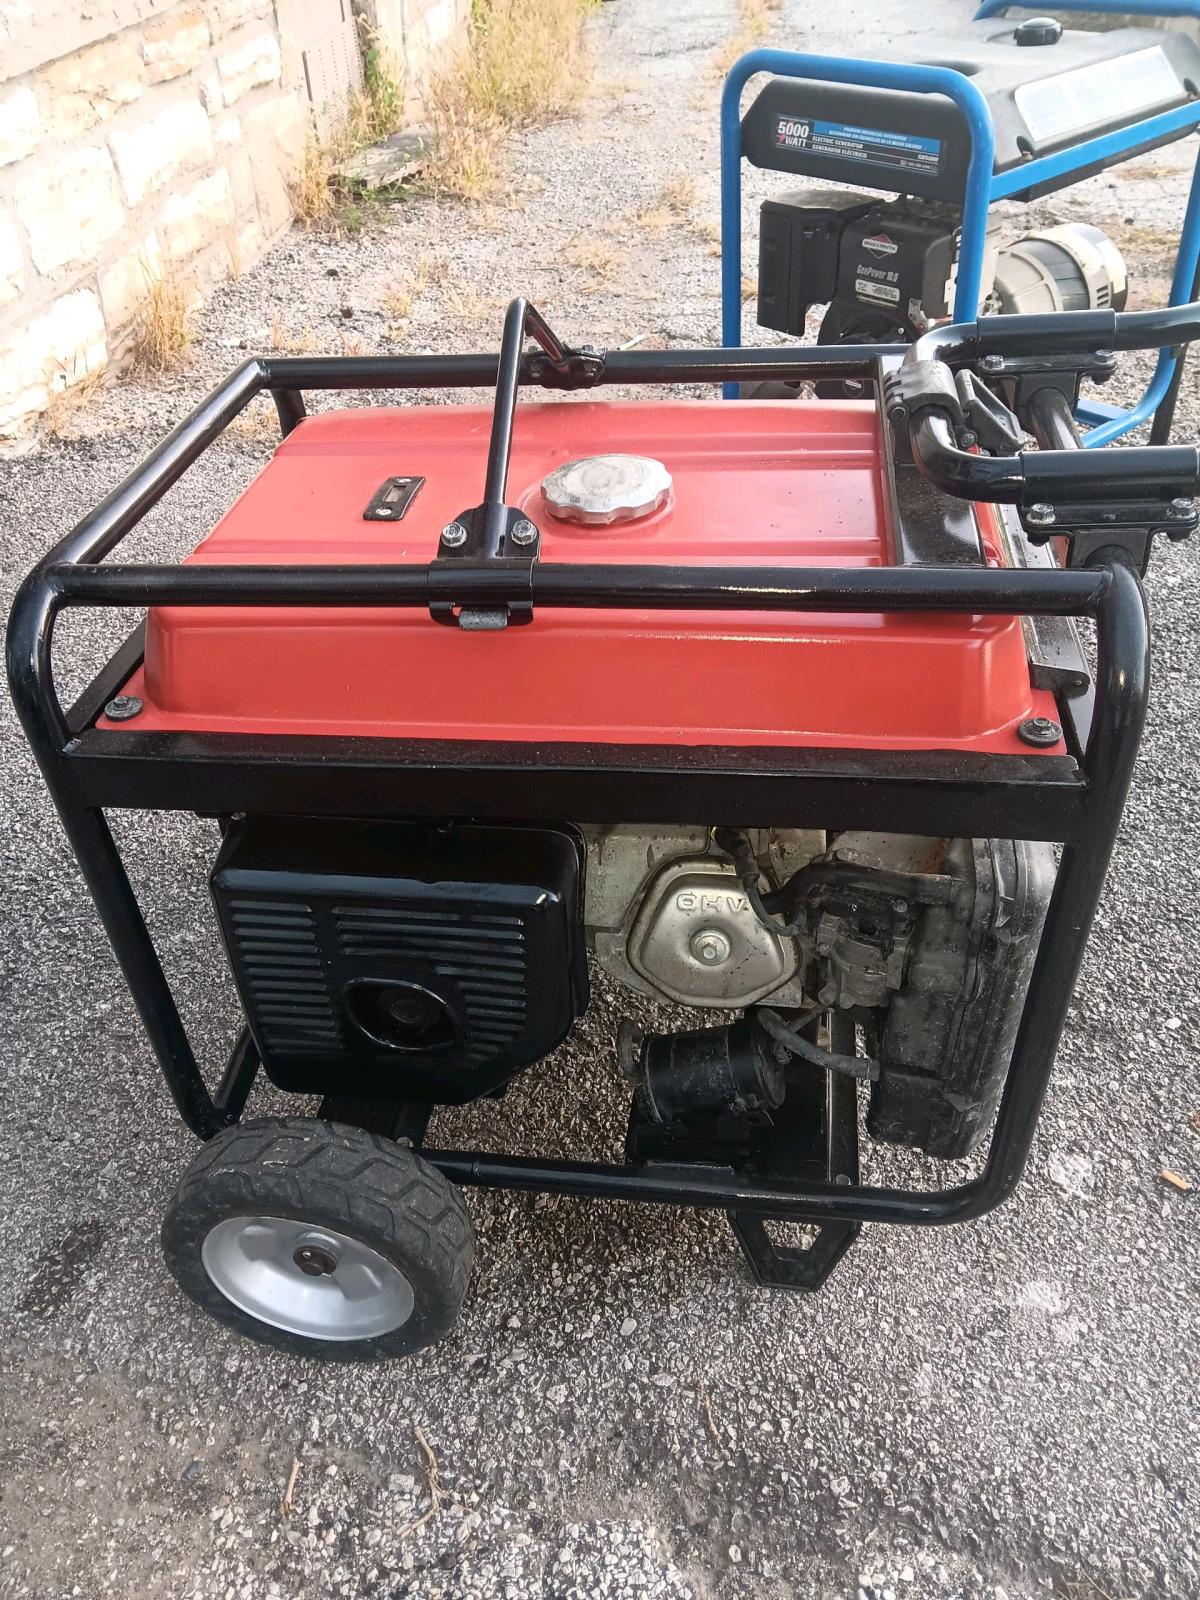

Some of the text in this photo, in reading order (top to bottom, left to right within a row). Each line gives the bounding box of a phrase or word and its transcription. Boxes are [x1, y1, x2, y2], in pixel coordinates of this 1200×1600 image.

[778, 120, 809, 138] 5000
[785, 136, 807, 148] WATT
[812, 136, 864, 149] ELECTRIC GENERATOR
[856, 264, 886, 279] GenPower
[677, 893, 746, 913] OHV
